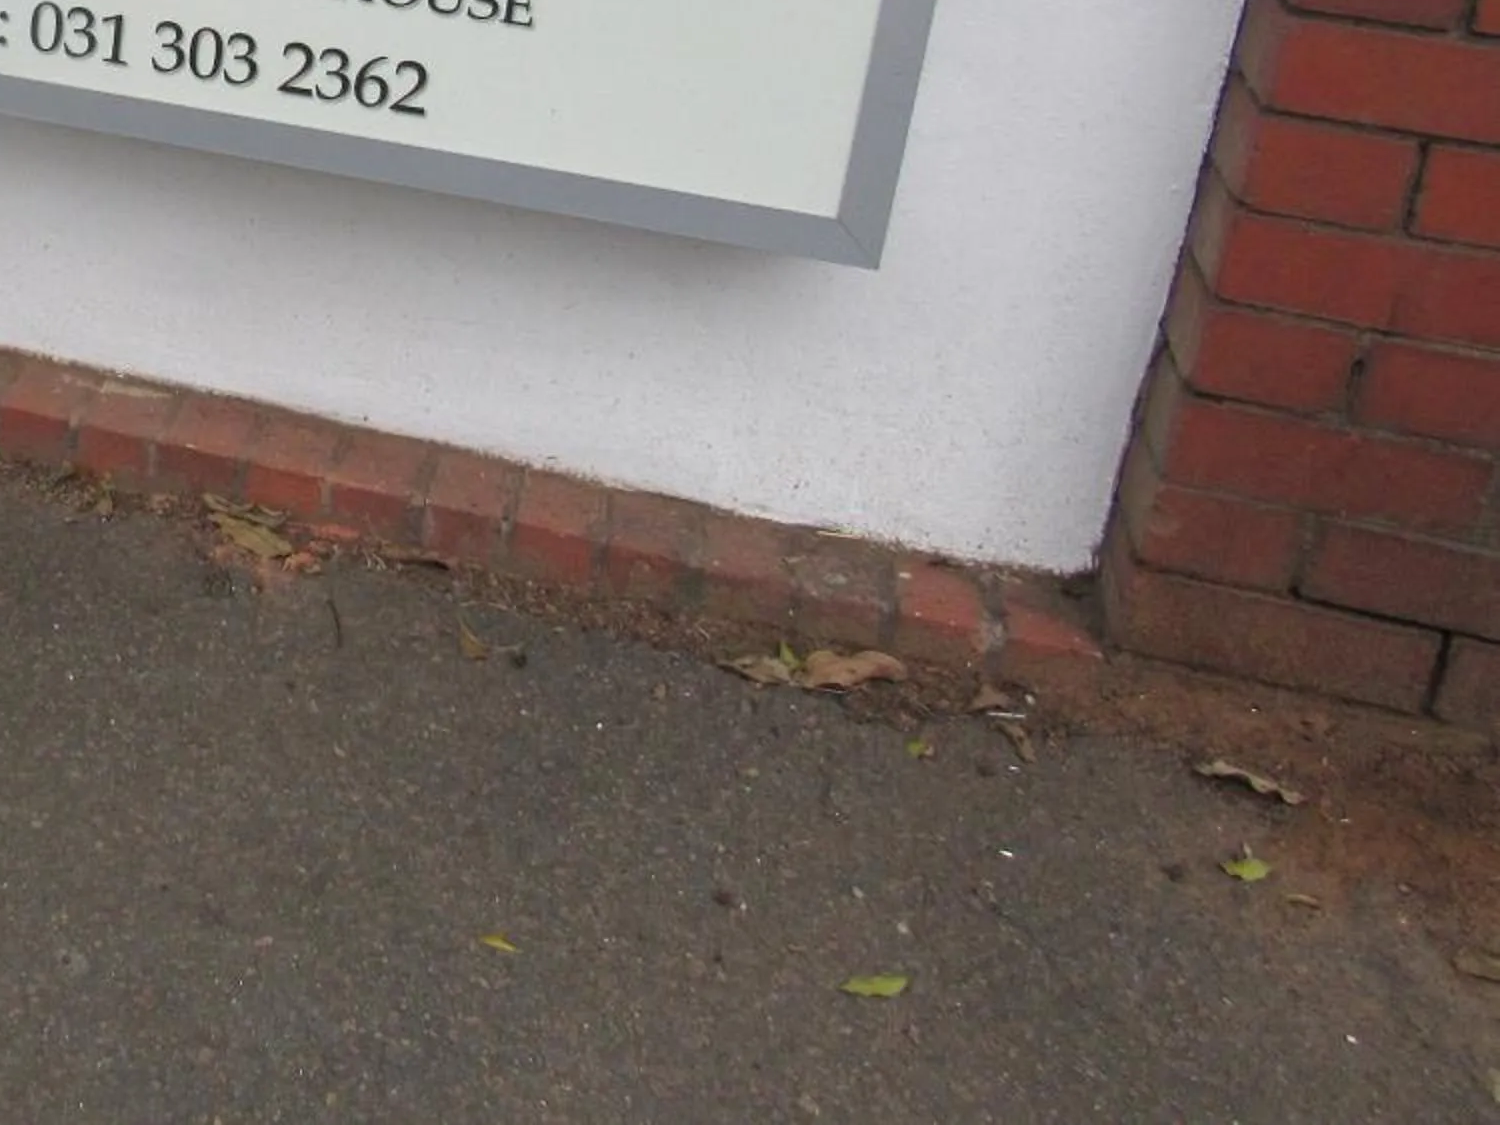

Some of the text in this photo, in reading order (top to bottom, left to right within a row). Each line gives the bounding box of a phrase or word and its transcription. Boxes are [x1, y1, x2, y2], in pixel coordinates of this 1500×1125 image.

[29, 1, 128, 67] 031
[150, 19, 259, 86] 303
[276, 41, 430, 118] 2362
